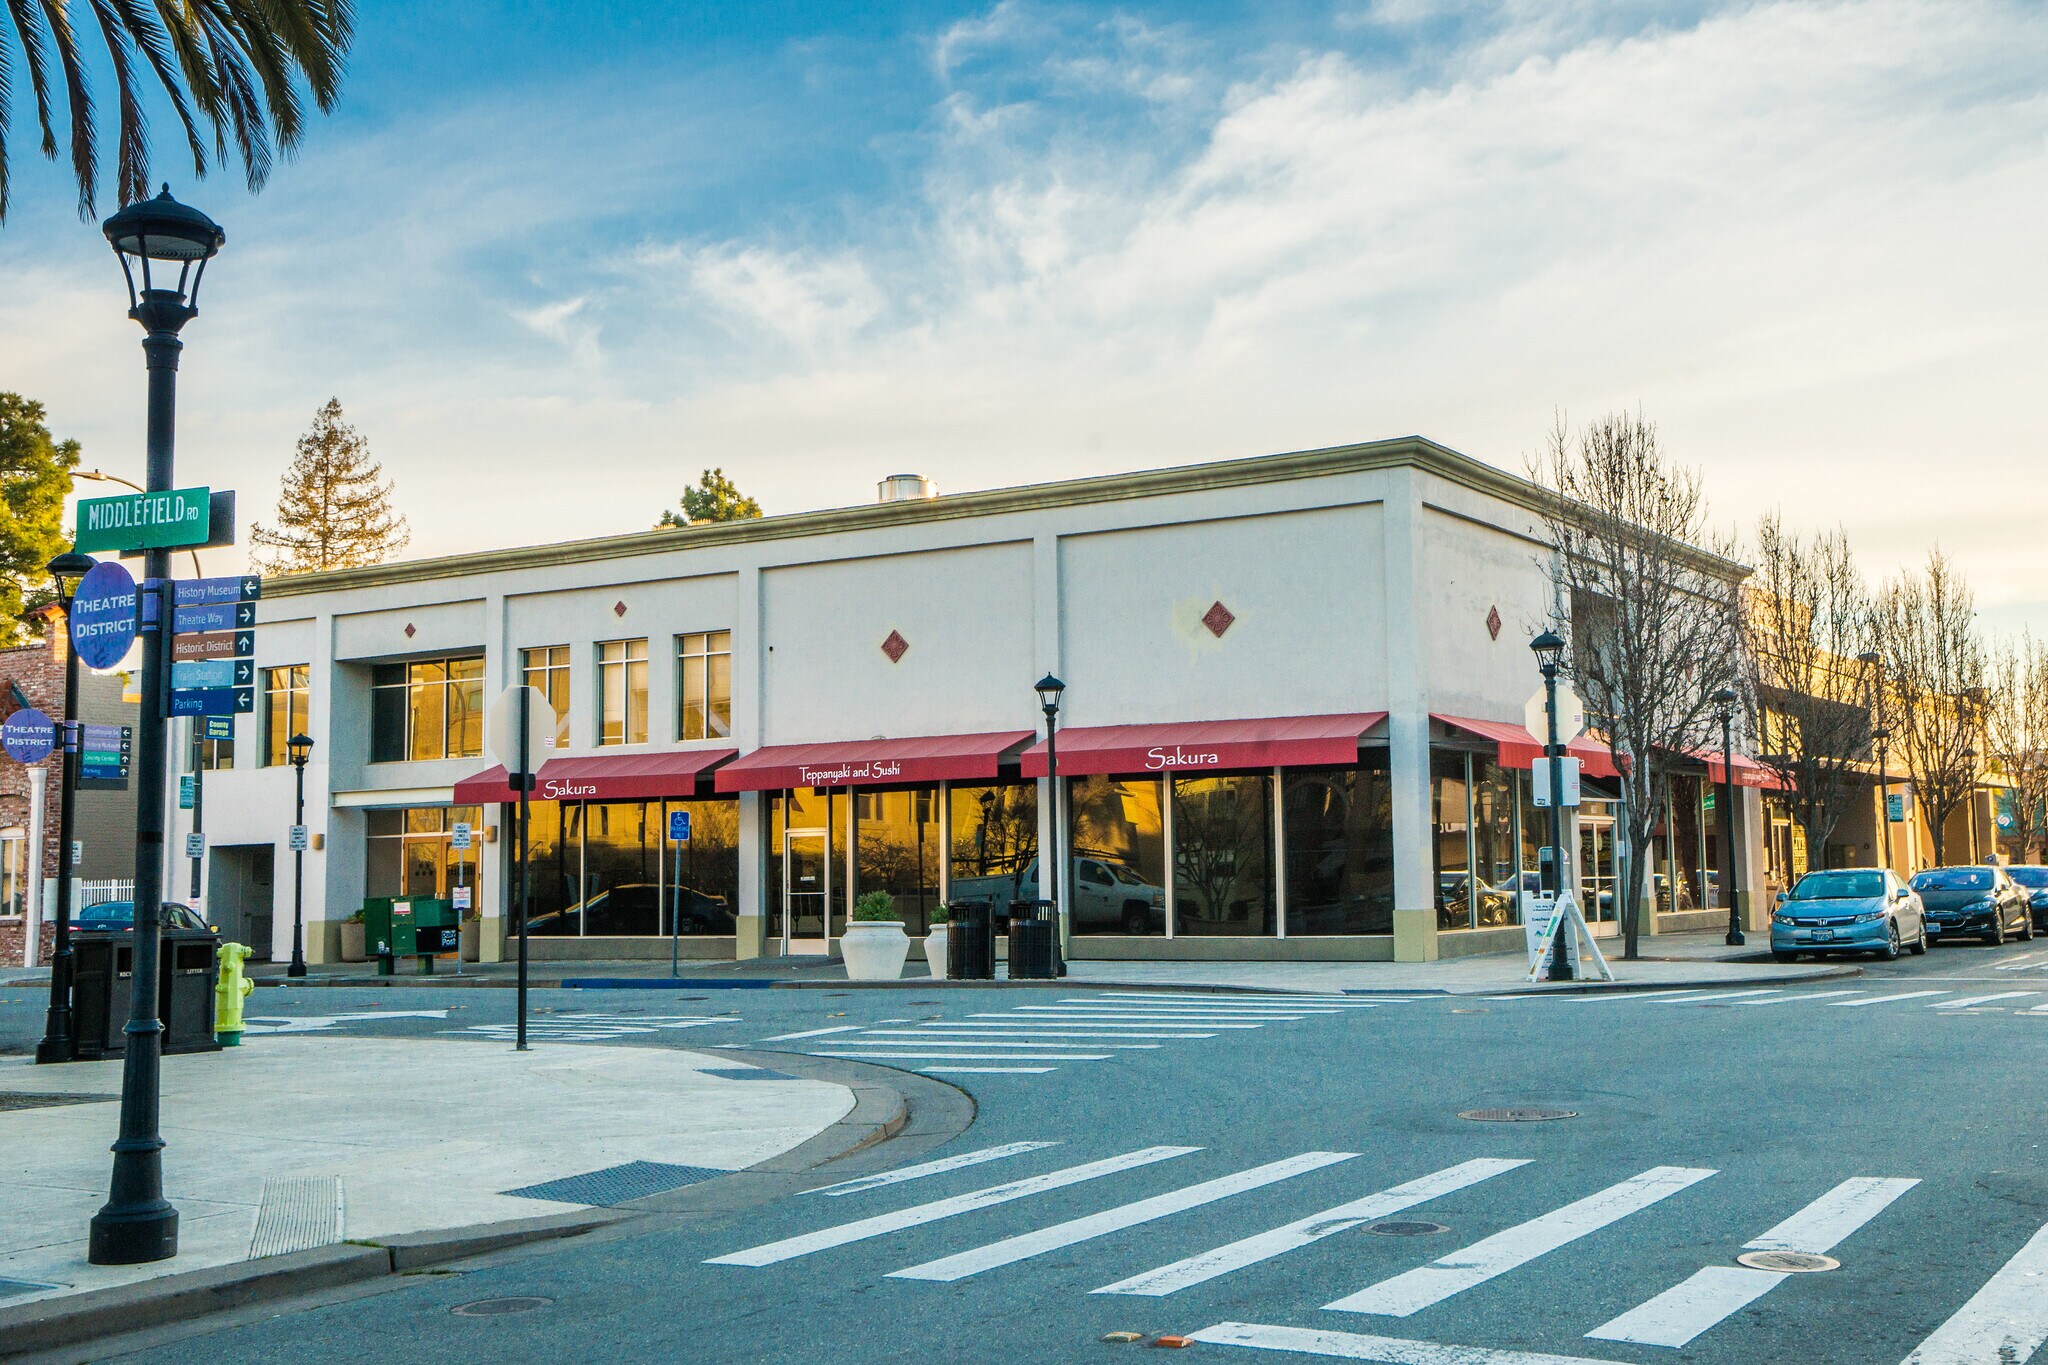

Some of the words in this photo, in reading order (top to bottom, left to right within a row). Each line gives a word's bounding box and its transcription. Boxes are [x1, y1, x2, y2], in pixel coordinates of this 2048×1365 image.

[88, 495, 185, 531] MIDDLEFIELD
[186, 506, 199, 521] RD
[178, 587, 206, 599] History
[207, 585, 241, 596] Museum
[75, 593, 136, 614] THEATRE
[178, 614, 206, 626] Theatre
[207, 612, 224, 625] Way
[76, 618, 135, 638] DISTRICT
[176, 641, 205, 654] Historic
[206, 640, 233, 652] District
[174, 698, 203, 711] Parking
[5, 725, 54, 734] THEATRE
[209, 720, 229, 729] County
[209, 728, 229, 737] Garage
[6, 737, 53, 746] DISTRICT
[1145, 746, 1219, 770] Sakura
[798, 763, 851, 786] Teppanyaki
[852, 762, 869, 778] and
[871, 760, 901, 779] Sushi
[543, 779, 597, 799] Sakura
